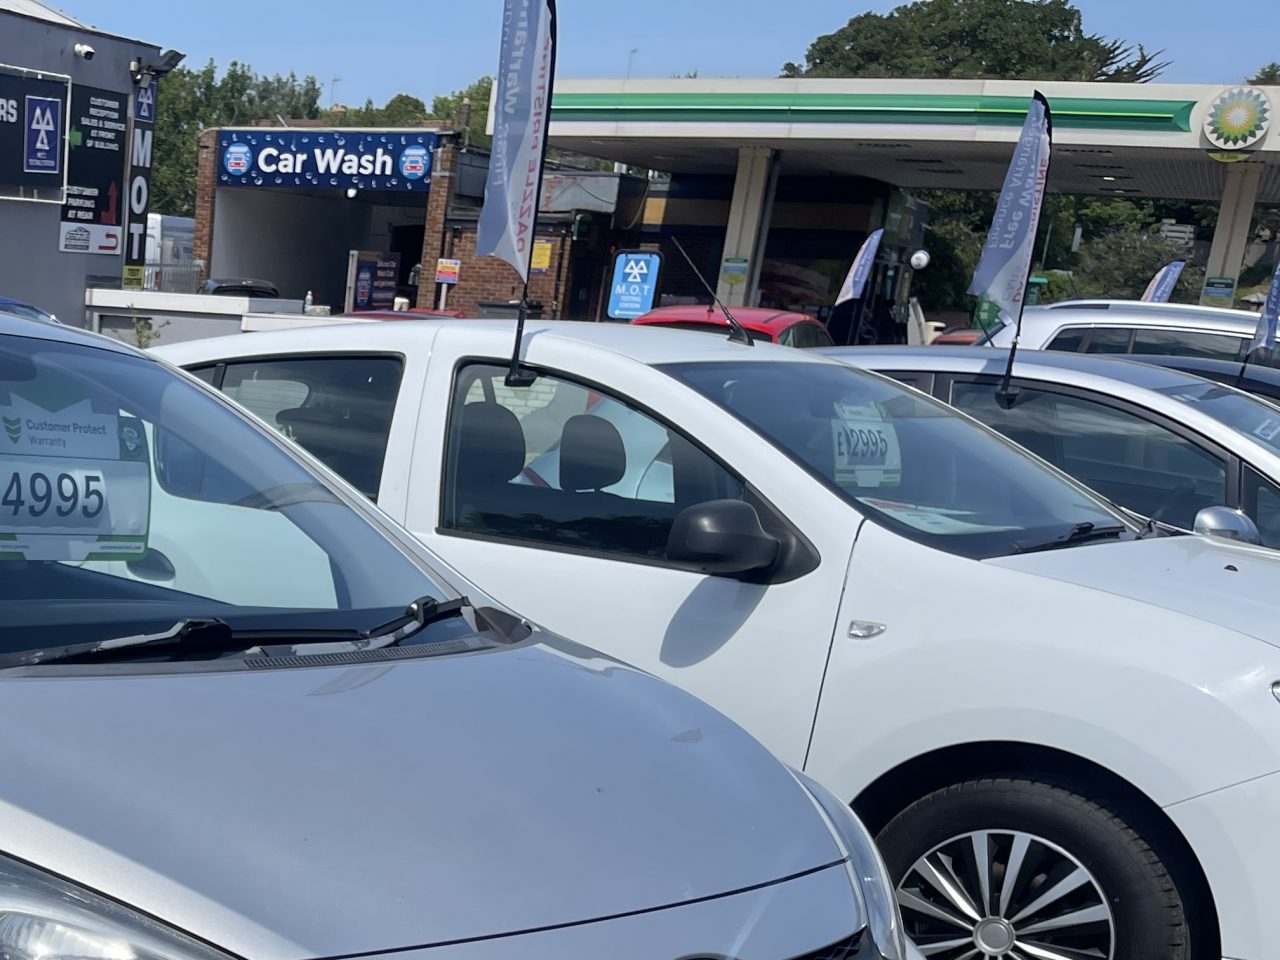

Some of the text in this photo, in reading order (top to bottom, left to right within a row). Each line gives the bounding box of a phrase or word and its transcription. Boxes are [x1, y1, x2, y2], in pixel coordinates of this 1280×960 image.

[257, 147, 394, 176] Car Wash
[26, 419, 107, 435] Customer Protect
[29, 435, 67, 449] Warranty
